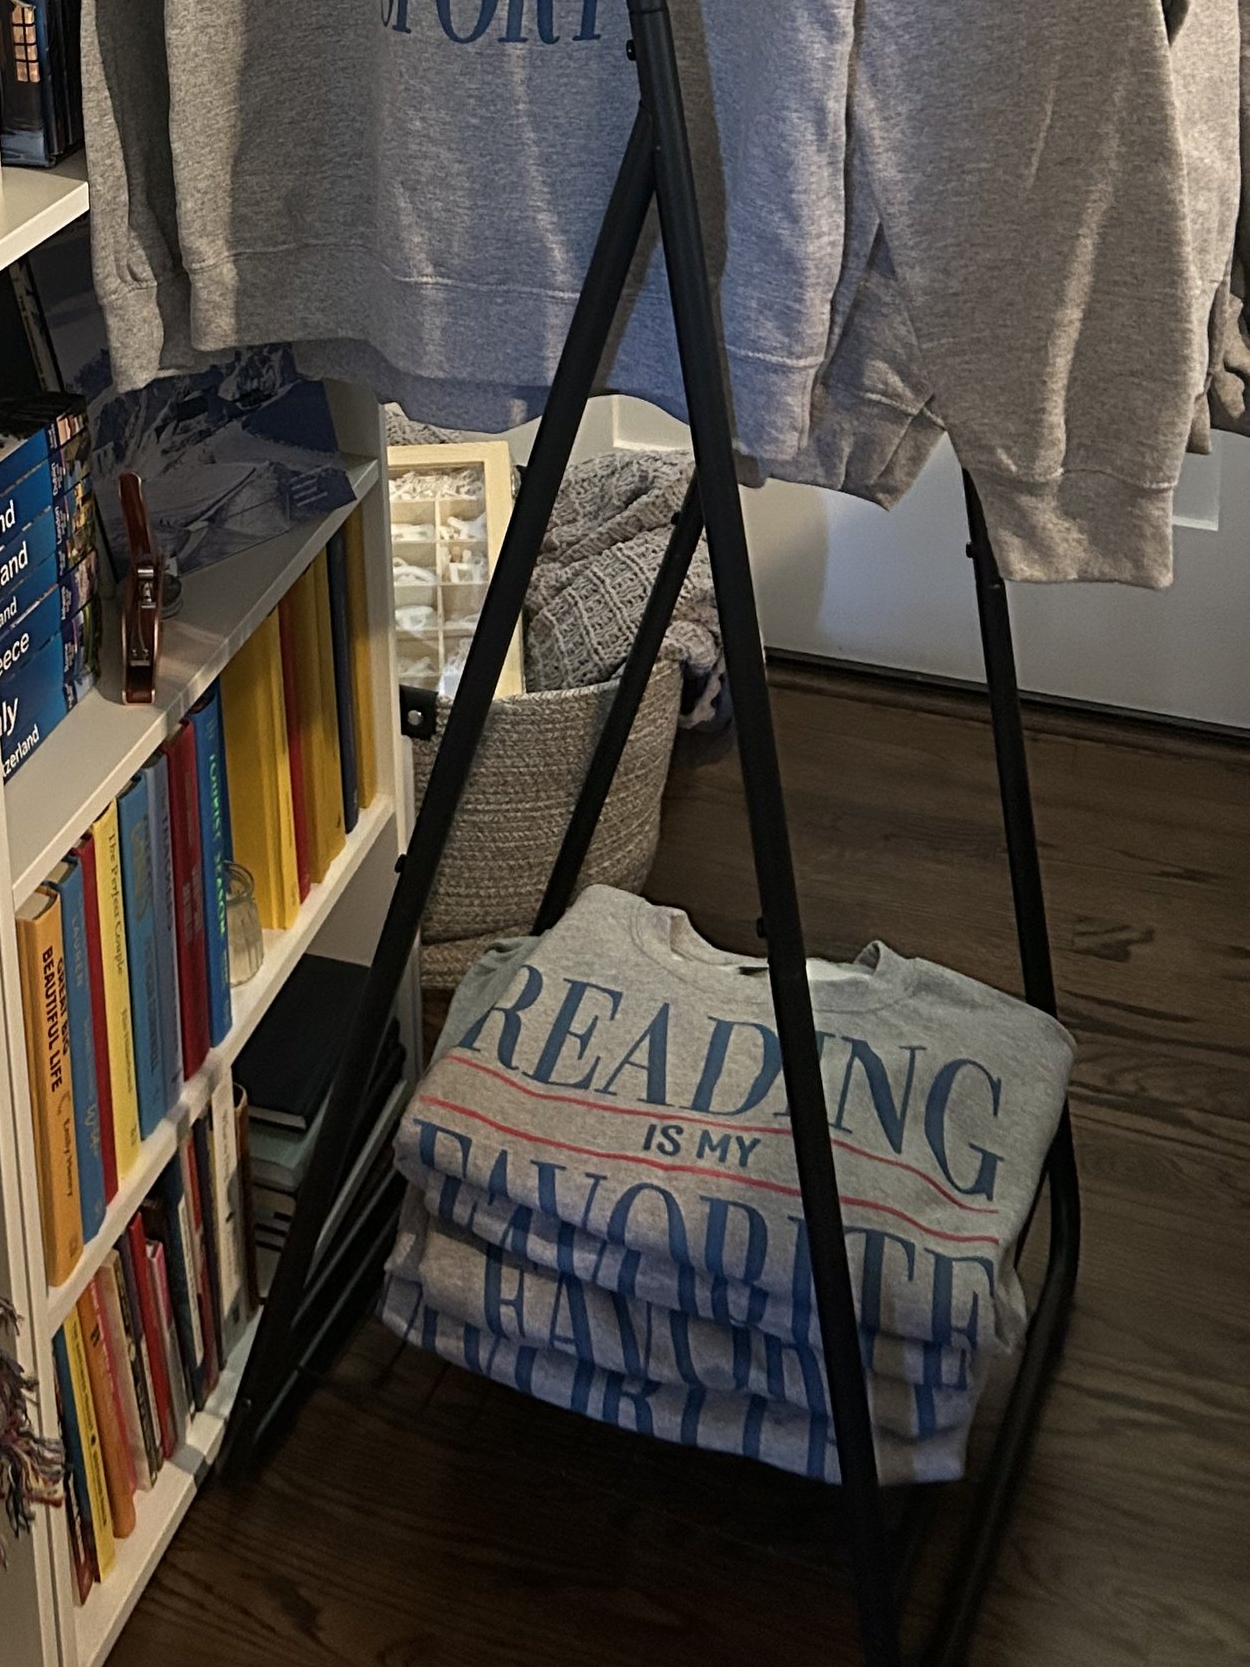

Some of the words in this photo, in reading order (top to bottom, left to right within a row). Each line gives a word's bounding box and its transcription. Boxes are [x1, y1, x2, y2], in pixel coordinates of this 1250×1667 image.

[41, 945, 62, 1051] BEAUTIFUL
[49, 1053, 63, 1093] LIFE
[642, 1124, 686, 1153] IS
[697, 1134, 761, 1168] MY
